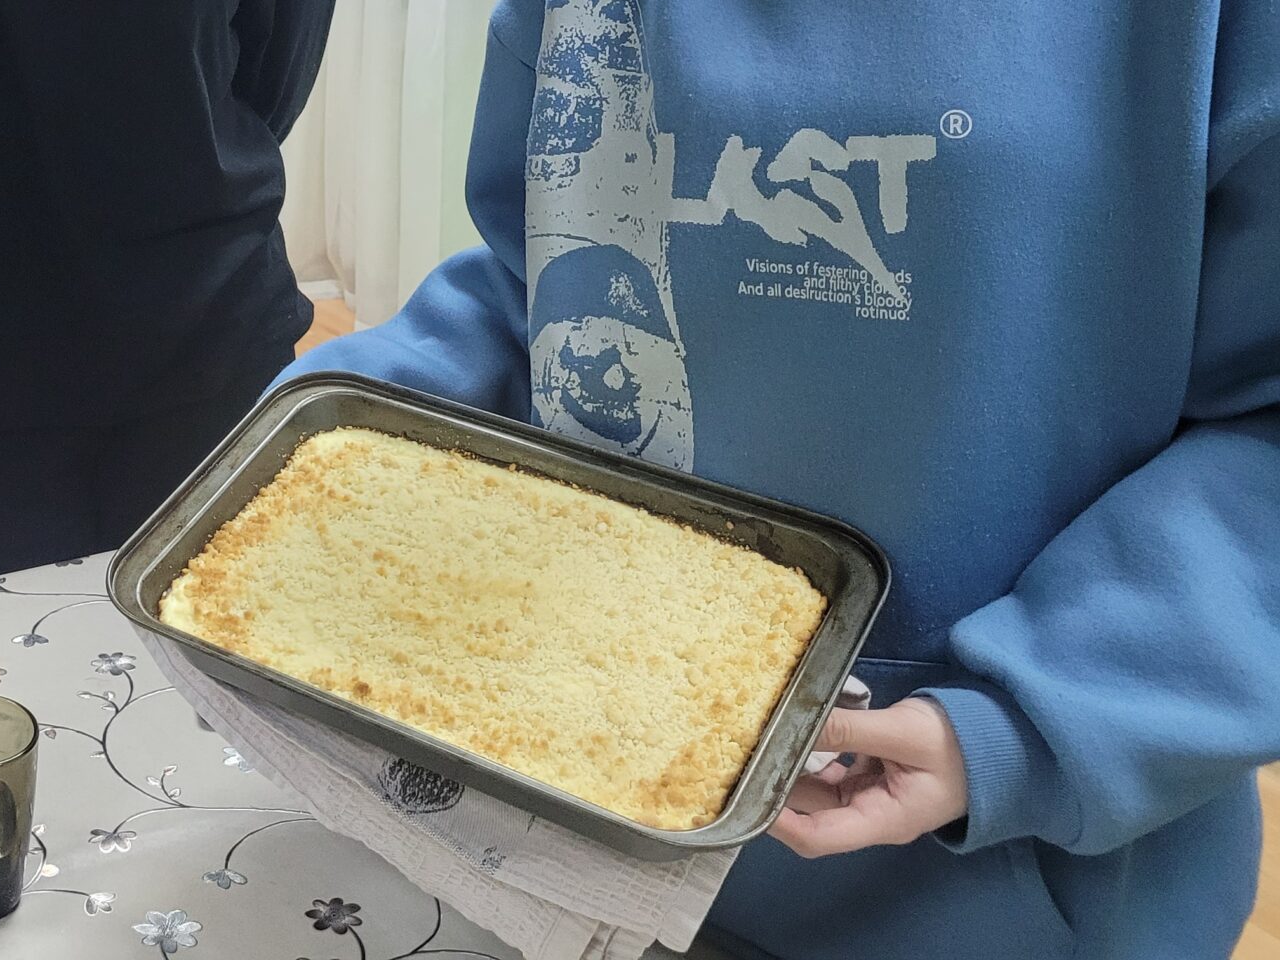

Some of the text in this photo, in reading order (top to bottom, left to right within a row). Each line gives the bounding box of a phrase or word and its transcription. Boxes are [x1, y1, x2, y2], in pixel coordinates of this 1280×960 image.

[746, 258, 793, 275] Visions
[796, 261, 811, 275] of
[813, 262, 868, 283] festering
[738, 281, 763, 296] And
[767, 283, 782, 297] all
[804, 276, 826, 289] and
[829, 277, 861, 295] filthy
